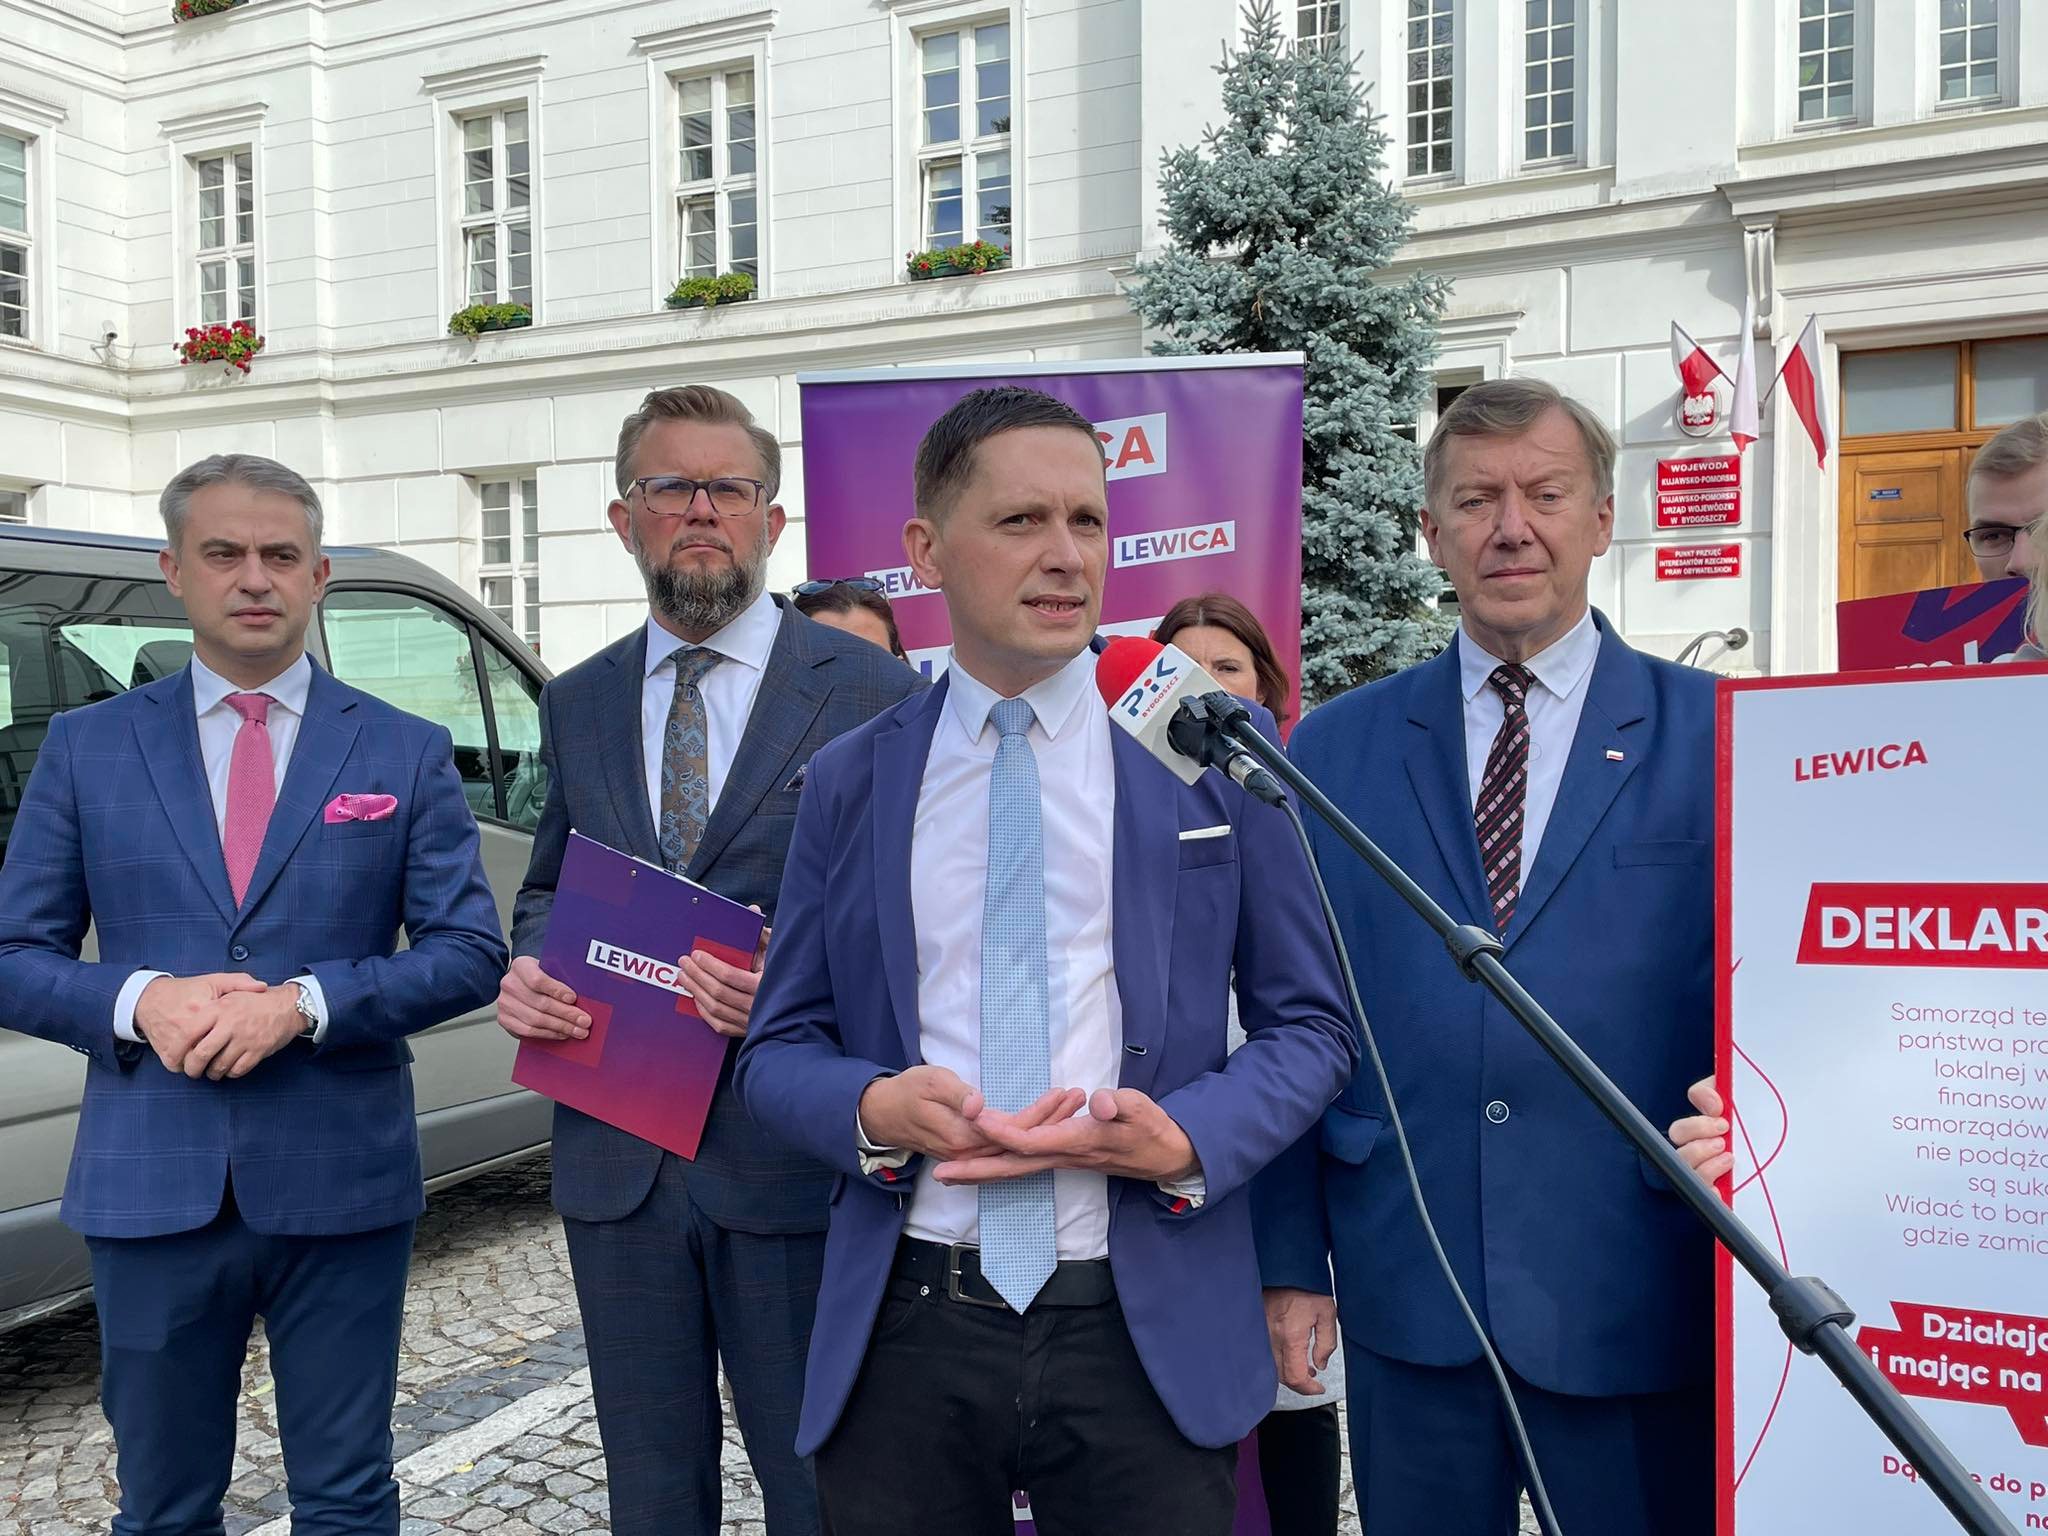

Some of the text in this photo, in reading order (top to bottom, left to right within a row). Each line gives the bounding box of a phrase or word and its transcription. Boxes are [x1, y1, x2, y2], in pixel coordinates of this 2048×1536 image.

[1671, 462, 1729, 473] WOJEWODA
[1661, 474, 1737, 486] KUJAWSKO-POMORSKI
[1661, 492, 1737, 504] KUJAWSKO-POMORSKI
[1663, 502, 1735, 515] URZĄD WOJEWÓDZKI
[1670, 514, 1728, 525] W BYDGOSZCZY
[1121, 527, 1229, 561] LEWICA
[1142, 675, 1179, 718] BYDGOSZCZ
[1795, 740, 1928, 782] LEWICA
[1821, 906, 2048, 952] DEKLAR
[1891, 1002, 2047, 1030] Samorząd te
[1899, 1031, 2003, 1053] państwa
[1935, 1058, 2025, 1087] lokalnej
[1938, 1086, 2047, 1110] finansow
[1892, 1114, 2048, 1141] samorządów
[1916, 1142, 1951, 1161] nie
[1968, 1176, 2048, 1198] są suk
[1885, 1193, 1965, 1218] Widać
[1972, 1202, 1996, 1221] to
[1903, 1226, 1970, 1247] gdzie
[1872, 1346, 2041, 1392] i mając na
[1990, 1473, 2022, 1493] do
